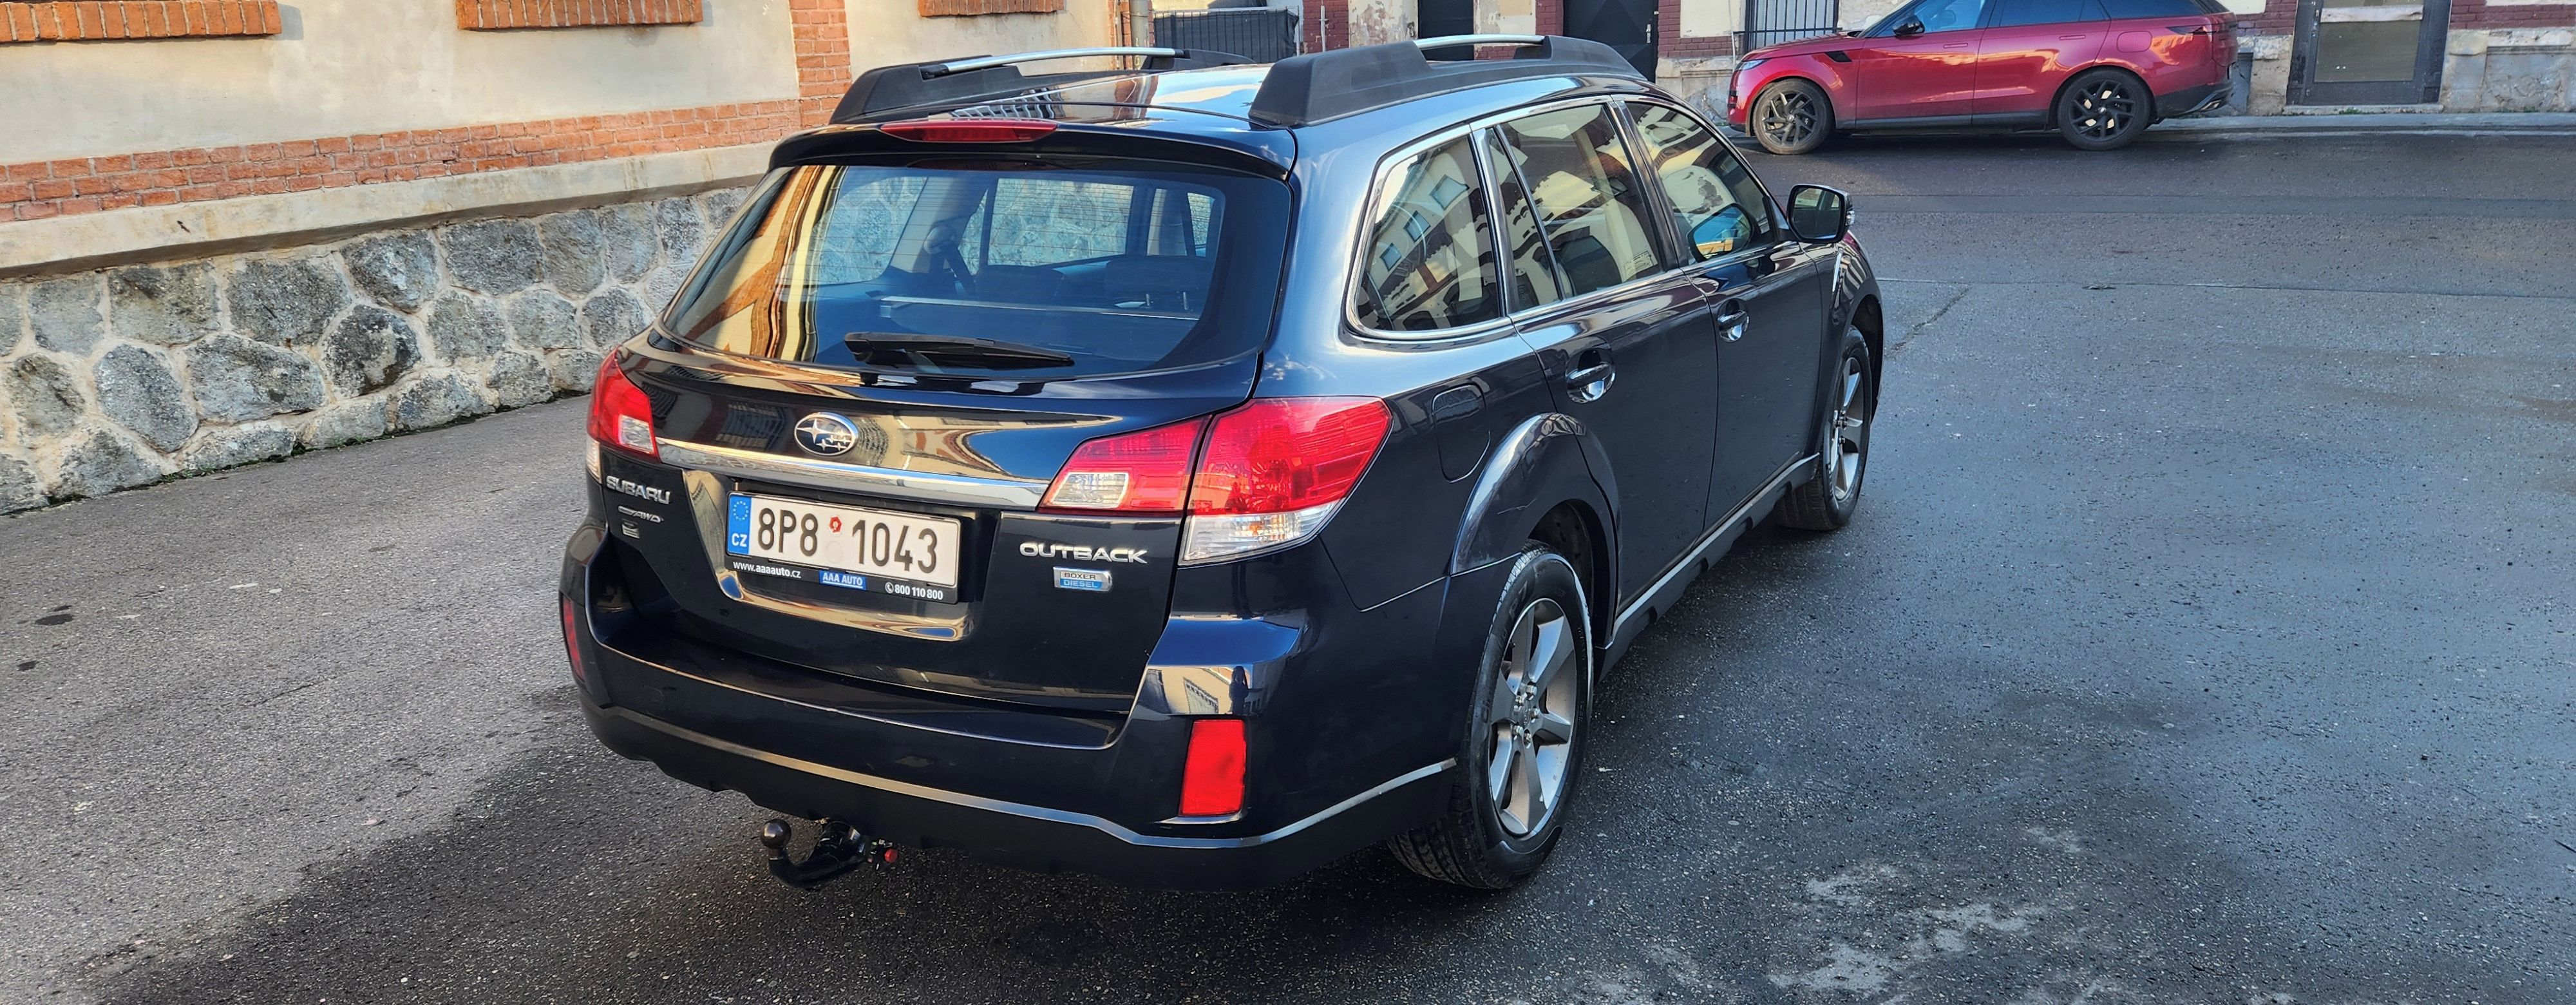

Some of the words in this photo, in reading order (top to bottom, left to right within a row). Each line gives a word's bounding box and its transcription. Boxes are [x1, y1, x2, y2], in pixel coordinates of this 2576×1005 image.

[606, 475, 670, 504] SUBARU
[732, 533, 747, 547] CZ
[757, 508, 819, 557] 8P8
[852, 519, 938, 573] 1043
[1019, 542, 1148, 564] OUTBACK
[733, 561, 802, 579] www.aaaauto.cz
[822, 572, 840, 583] AAA
[841, 575, 863, 586] AUTO
[894, 584, 910, 595] 800
[912, 587, 926, 598] 110
[927, 589, 943, 600] 800
